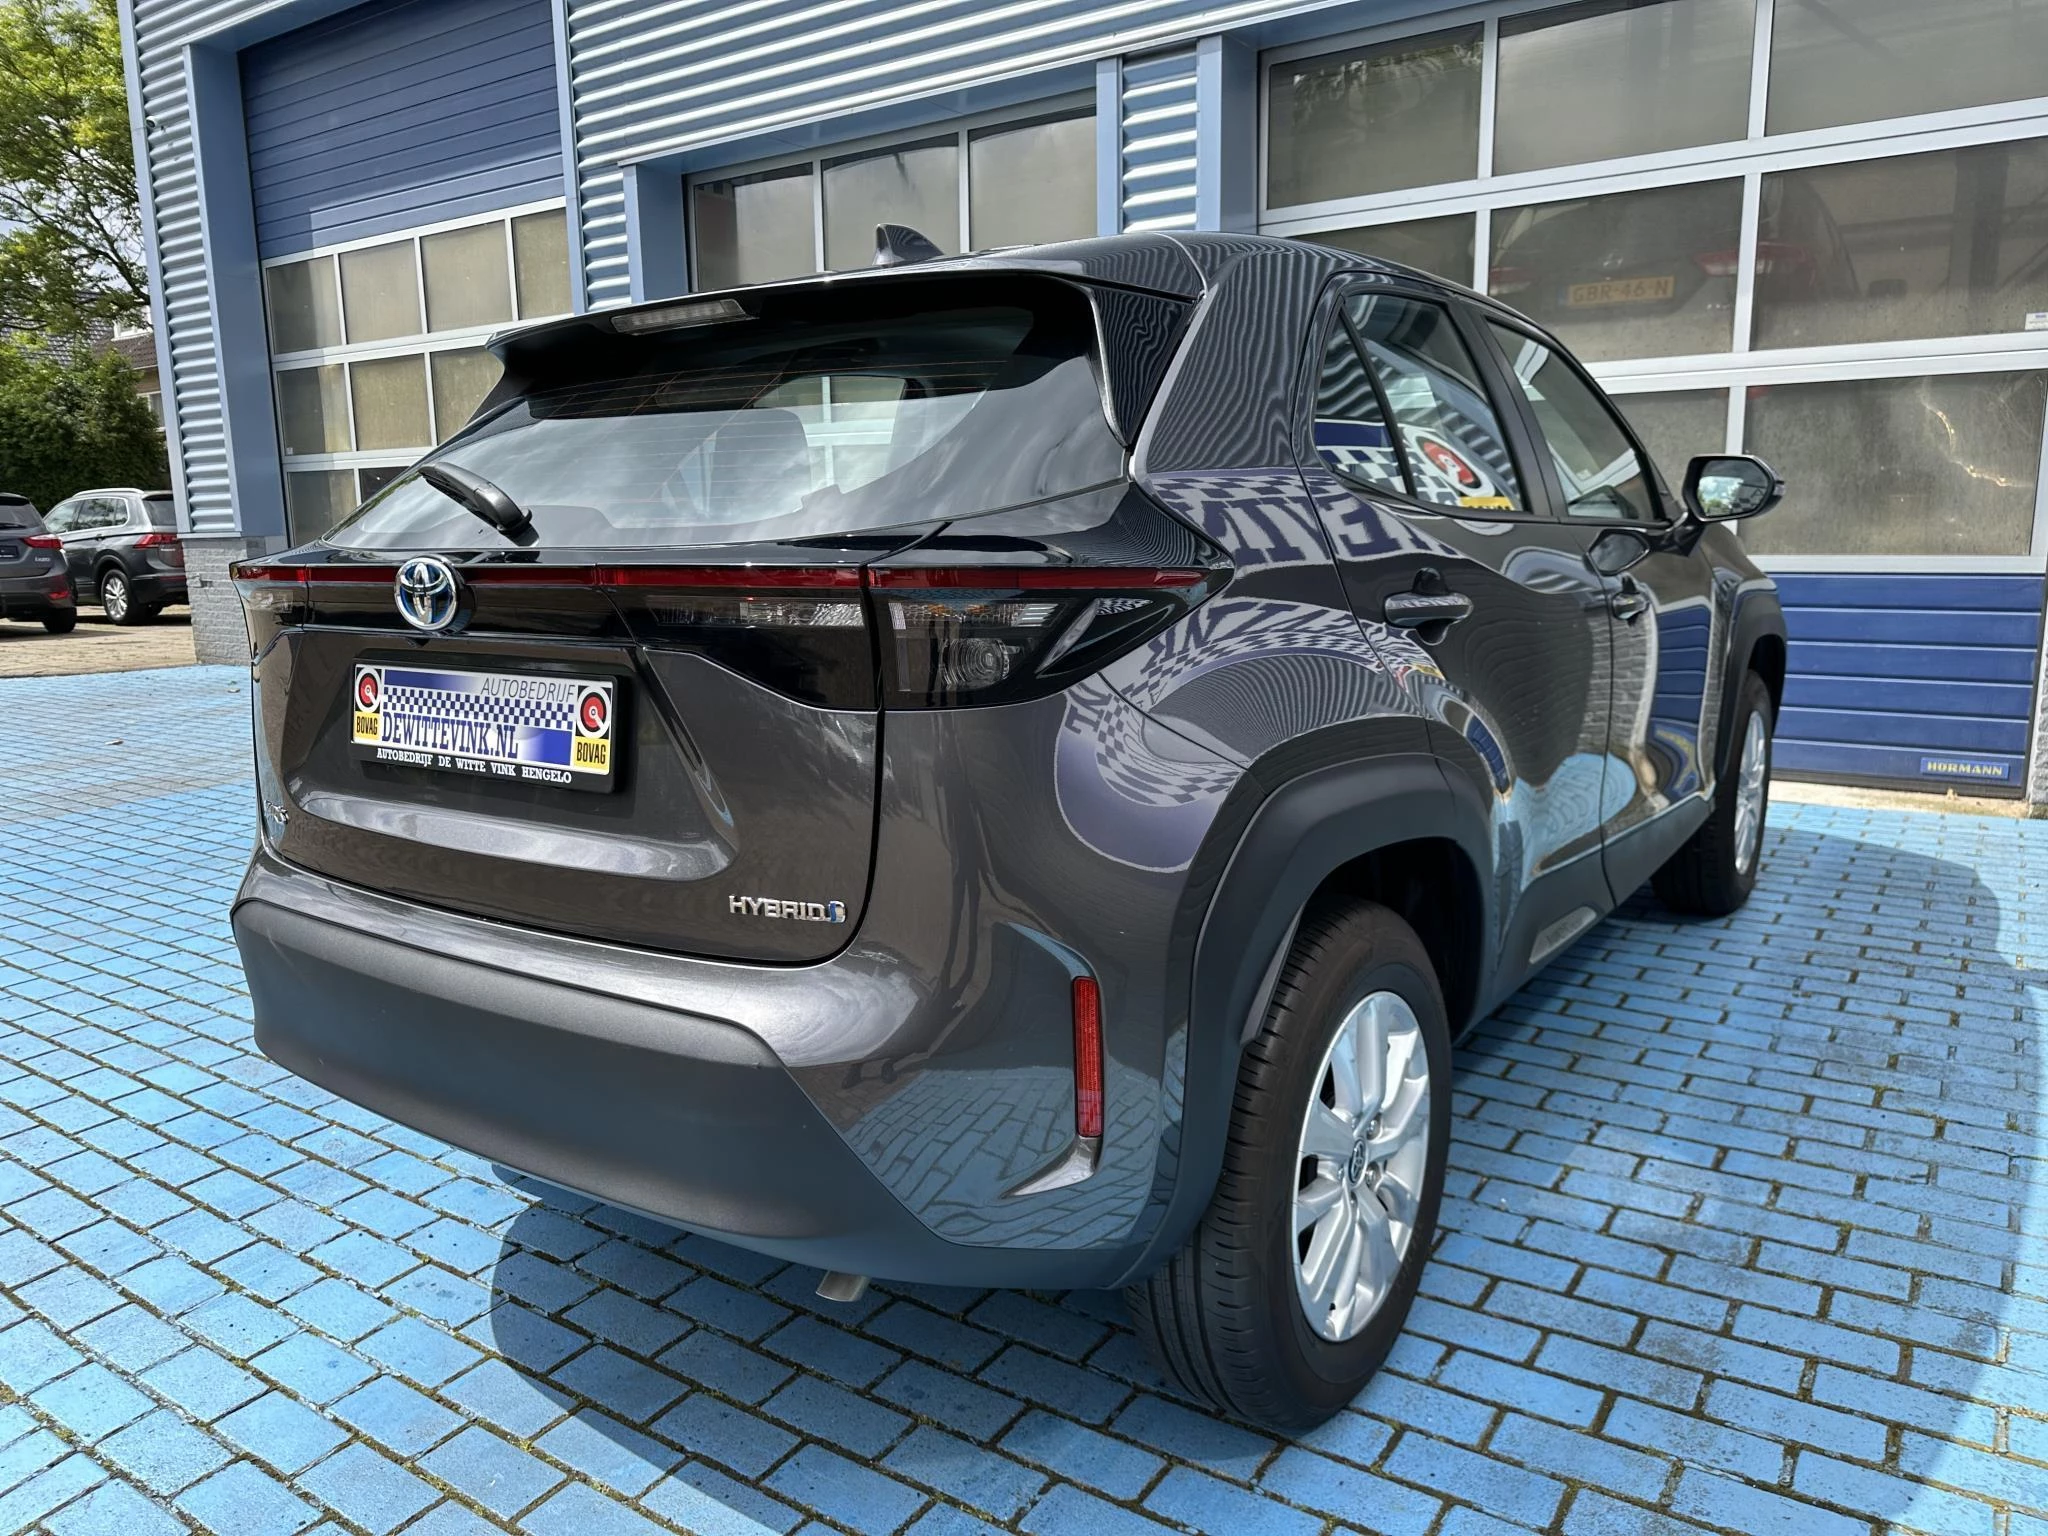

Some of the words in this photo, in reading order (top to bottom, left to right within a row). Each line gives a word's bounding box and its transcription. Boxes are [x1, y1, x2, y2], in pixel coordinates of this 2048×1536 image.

[1573, 279, 1669, 303] GBR-46-N
[480, 678, 576, 703] AUTOBEDRIJF
[356, 716, 378, 735] BOVAG
[382, 712, 519, 759] DEWITTEVINK.NL
[376, 748, 434, 767] AUTOBEDRIJF
[438, 755, 452, 768] DE
[456, 758, 486, 773] WITTE
[490, 762, 516, 776] VINK
[521, 767, 572, 784] HENGELO
[576, 742, 607, 765] BOVAG
[728, 895, 826, 922] HYBRID
